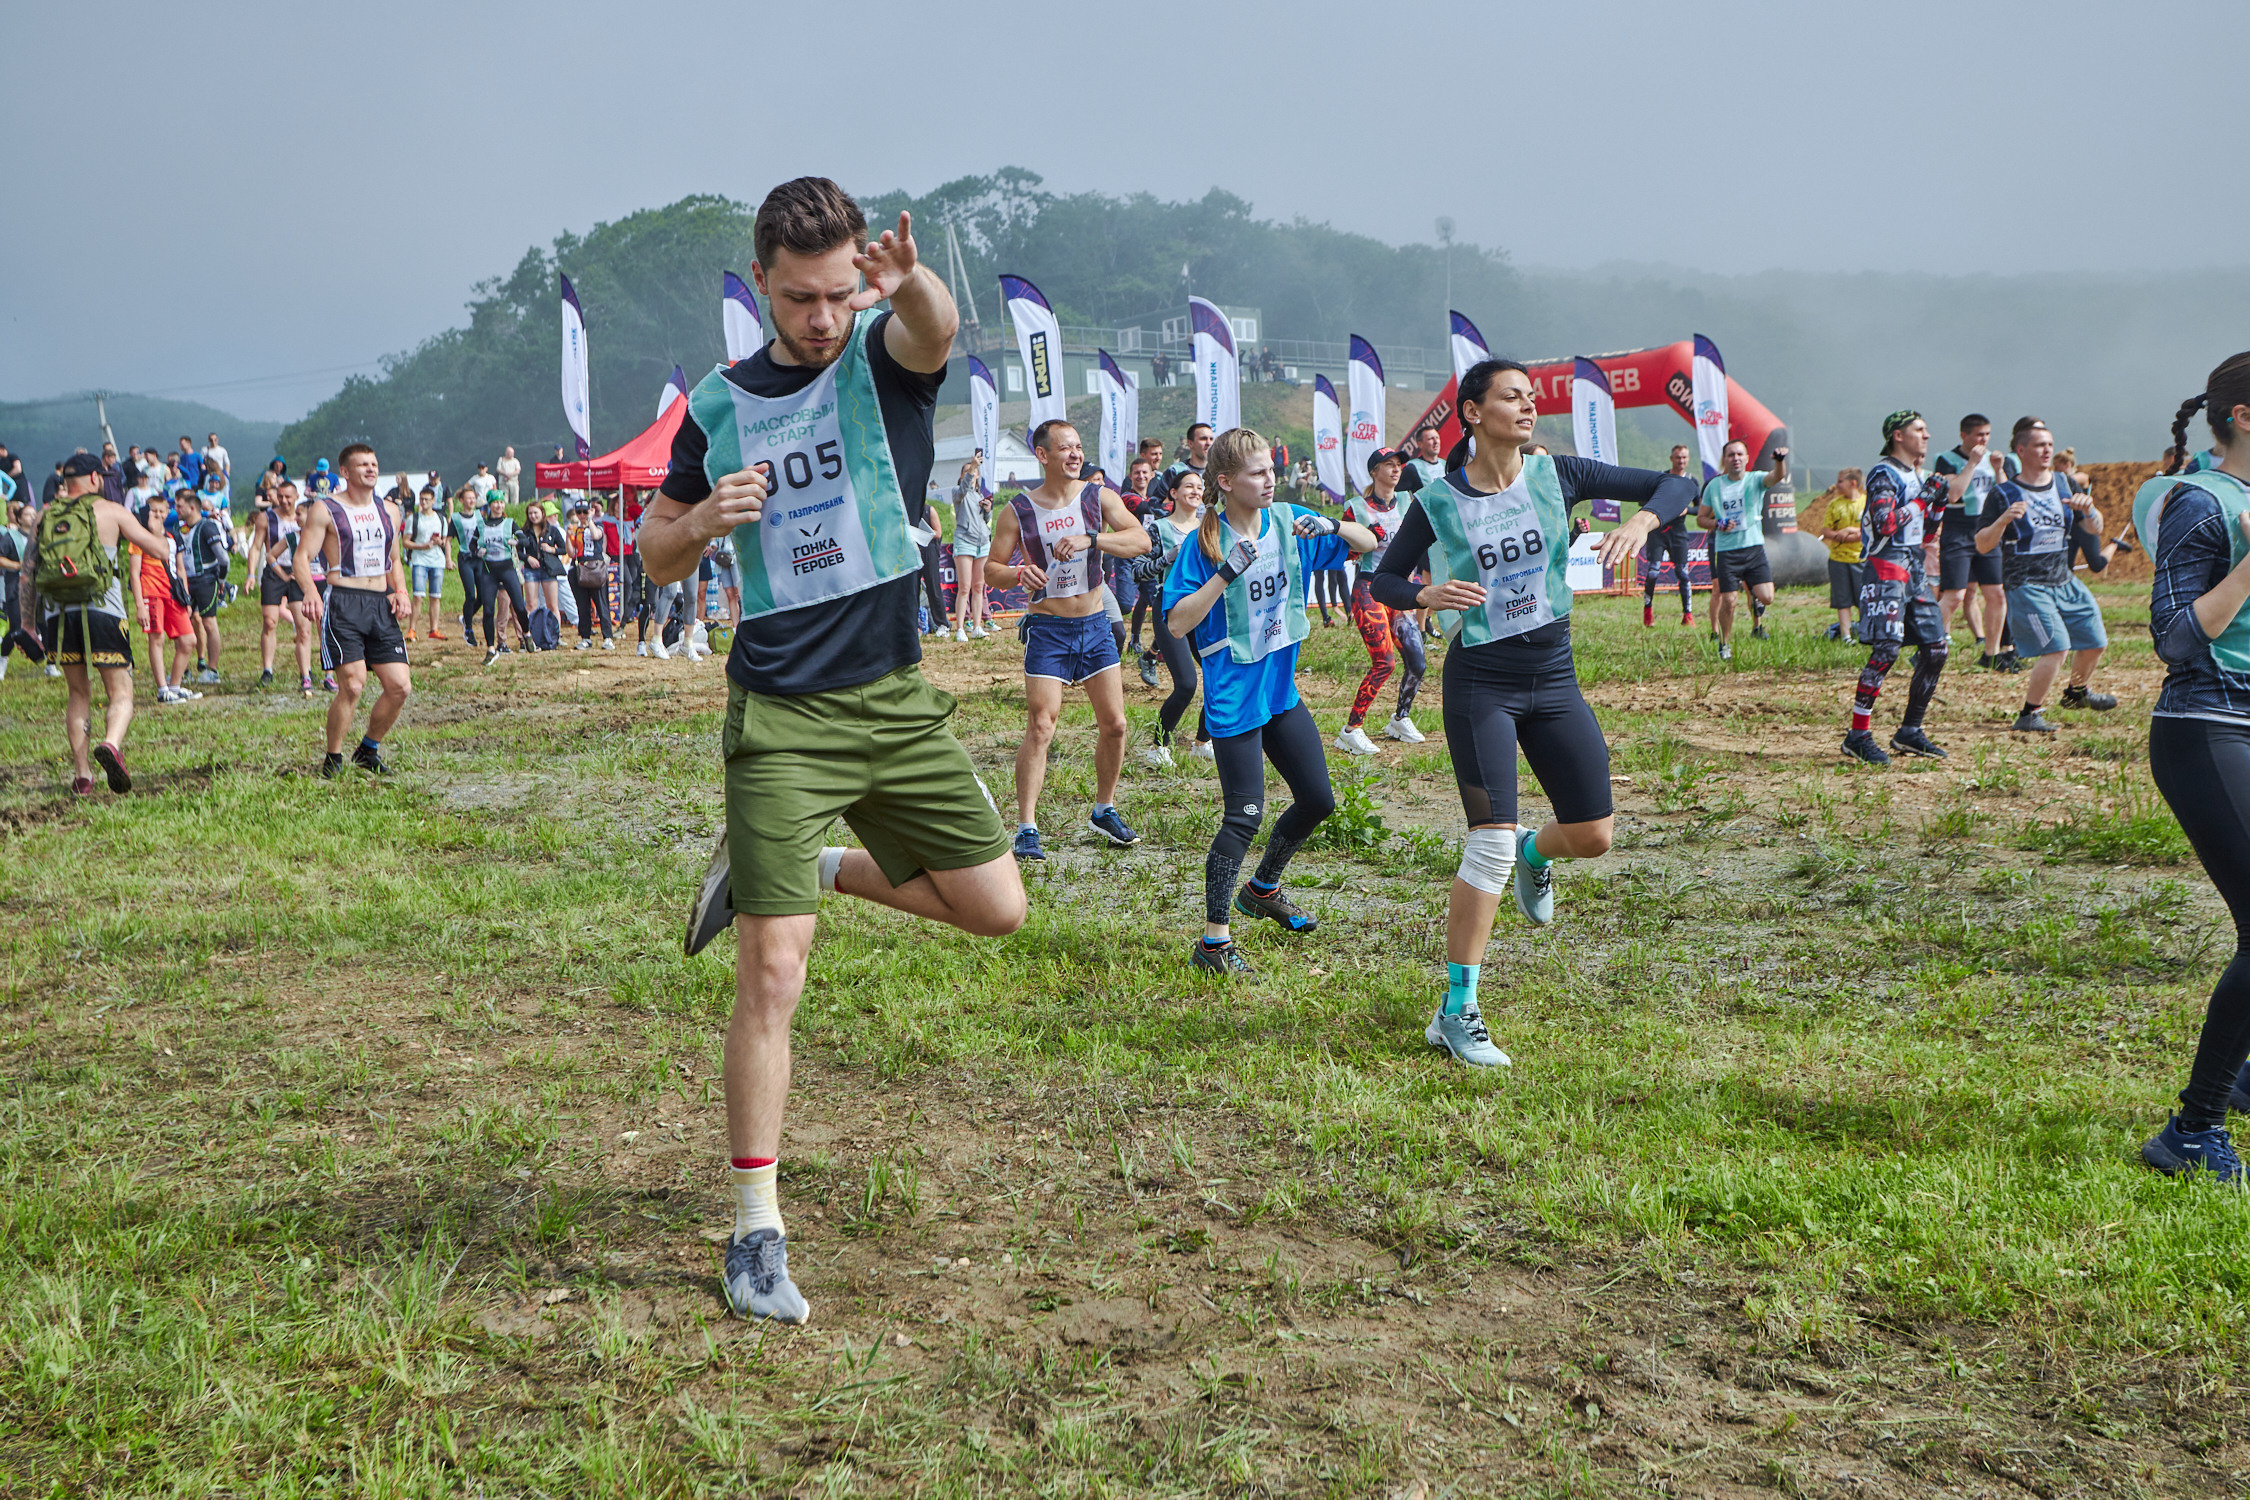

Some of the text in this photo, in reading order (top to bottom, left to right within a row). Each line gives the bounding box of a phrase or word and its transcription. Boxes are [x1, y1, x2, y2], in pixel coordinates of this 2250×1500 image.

[1552, 368, 1641, 398] ГЕЕВ
[743, 400, 834, 438] МАССОВЫЙ
[766, 424, 816, 447] СТАРТ
[354, 512, 375, 524] PRO
[788, 495, 845, 520] ГАЗПРОМБАНК
[1466, 502, 1532, 531] МАССОВЫЙ
[356, 527, 383, 542] 114
[1045, 516, 1075, 533] PRO
[1485, 518, 1520, 536] СТАРТ
[792, 537, 838, 559] ГОНКА
[1477, 529, 1543, 571] 668
[793, 552, 845, 576] ГЕРОЕВ
[1502, 565, 1544, 583] ГАЗПРОМБАНК
[1505, 593, 1537, 609] ГОНКА
